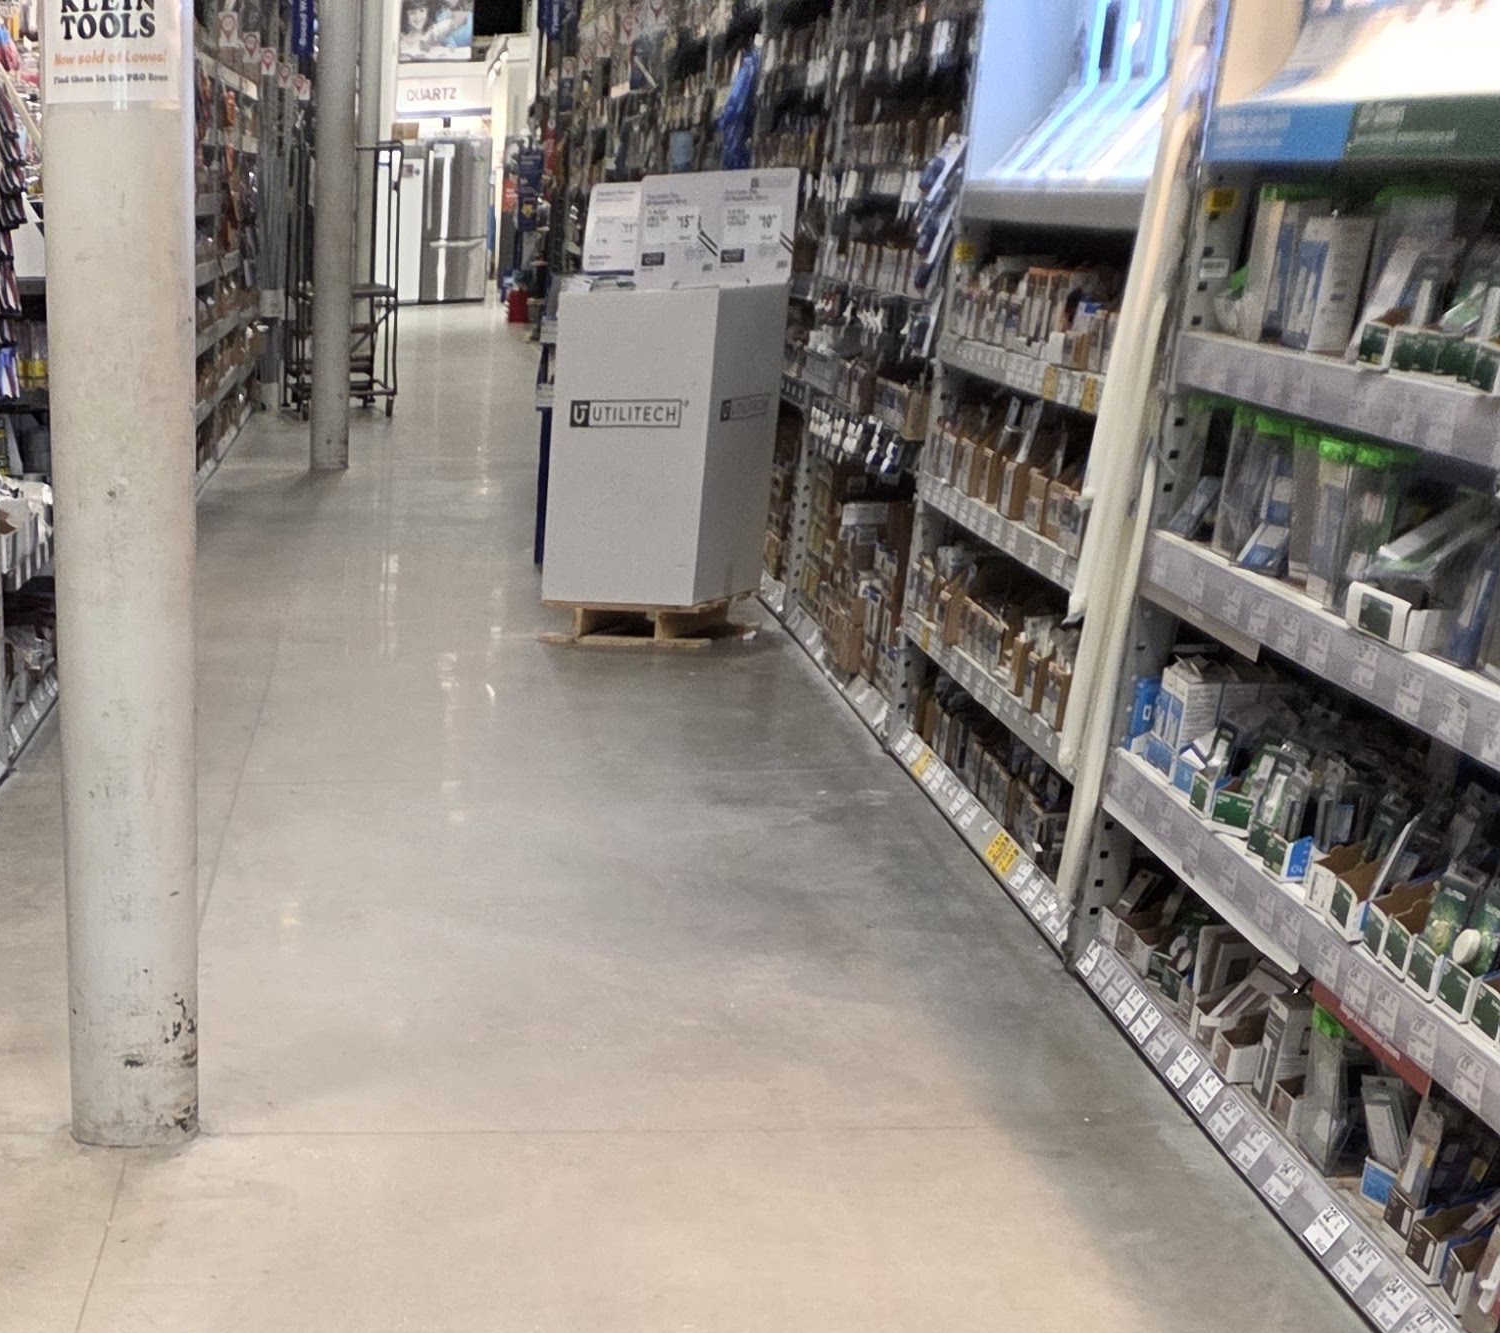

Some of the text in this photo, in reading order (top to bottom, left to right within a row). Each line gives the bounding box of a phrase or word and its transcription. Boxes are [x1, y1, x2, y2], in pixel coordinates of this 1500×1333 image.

[61, 13, 156, 40] TOOLS
[78, 49, 105, 64] sold
[406, 86, 457, 101] QUARTZ
[592, 405, 677, 423] UTILITECH
